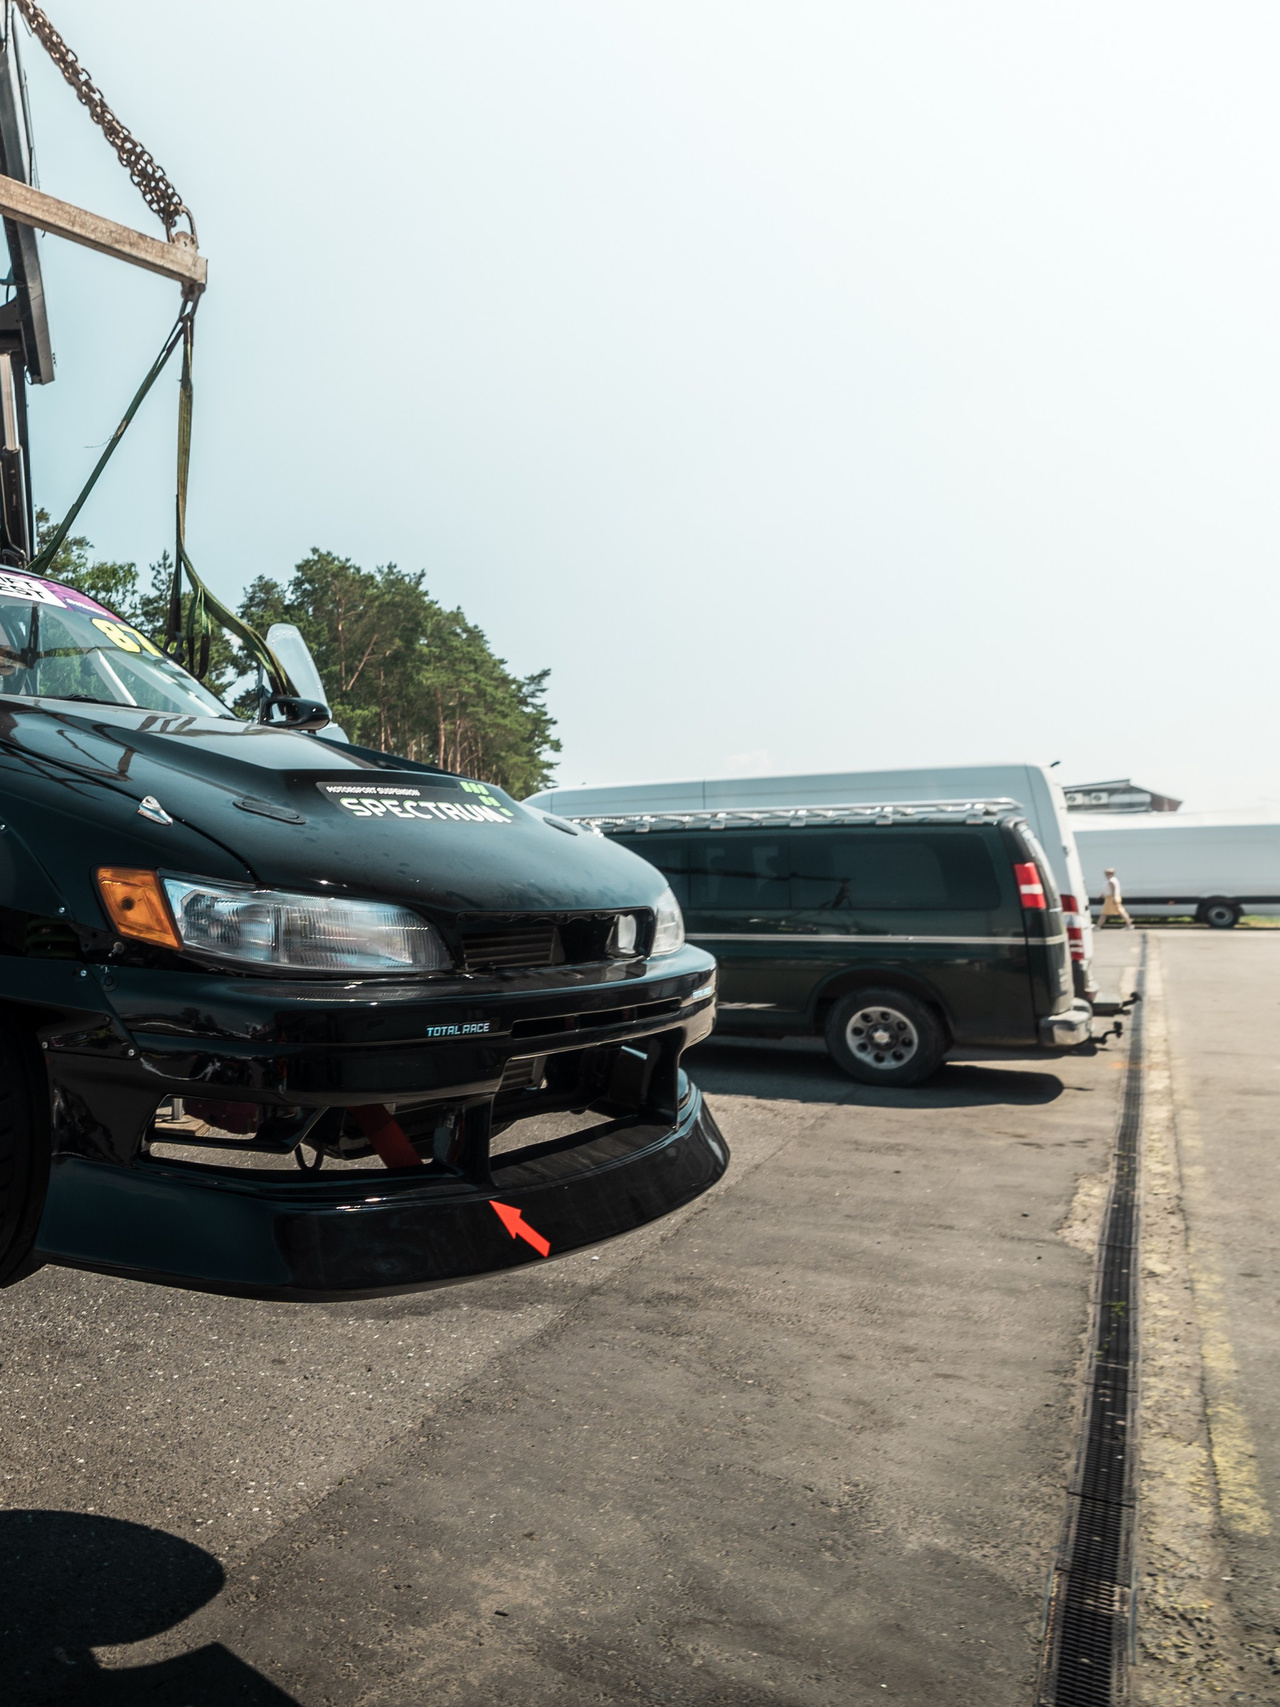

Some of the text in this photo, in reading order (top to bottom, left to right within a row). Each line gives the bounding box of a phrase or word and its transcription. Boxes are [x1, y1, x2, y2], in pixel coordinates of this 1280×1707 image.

[91, 617, 164, 659] 87
[340, 797, 512, 824] SPECTRUM
[427, 1022, 490, 1037] TOTAL RACE
